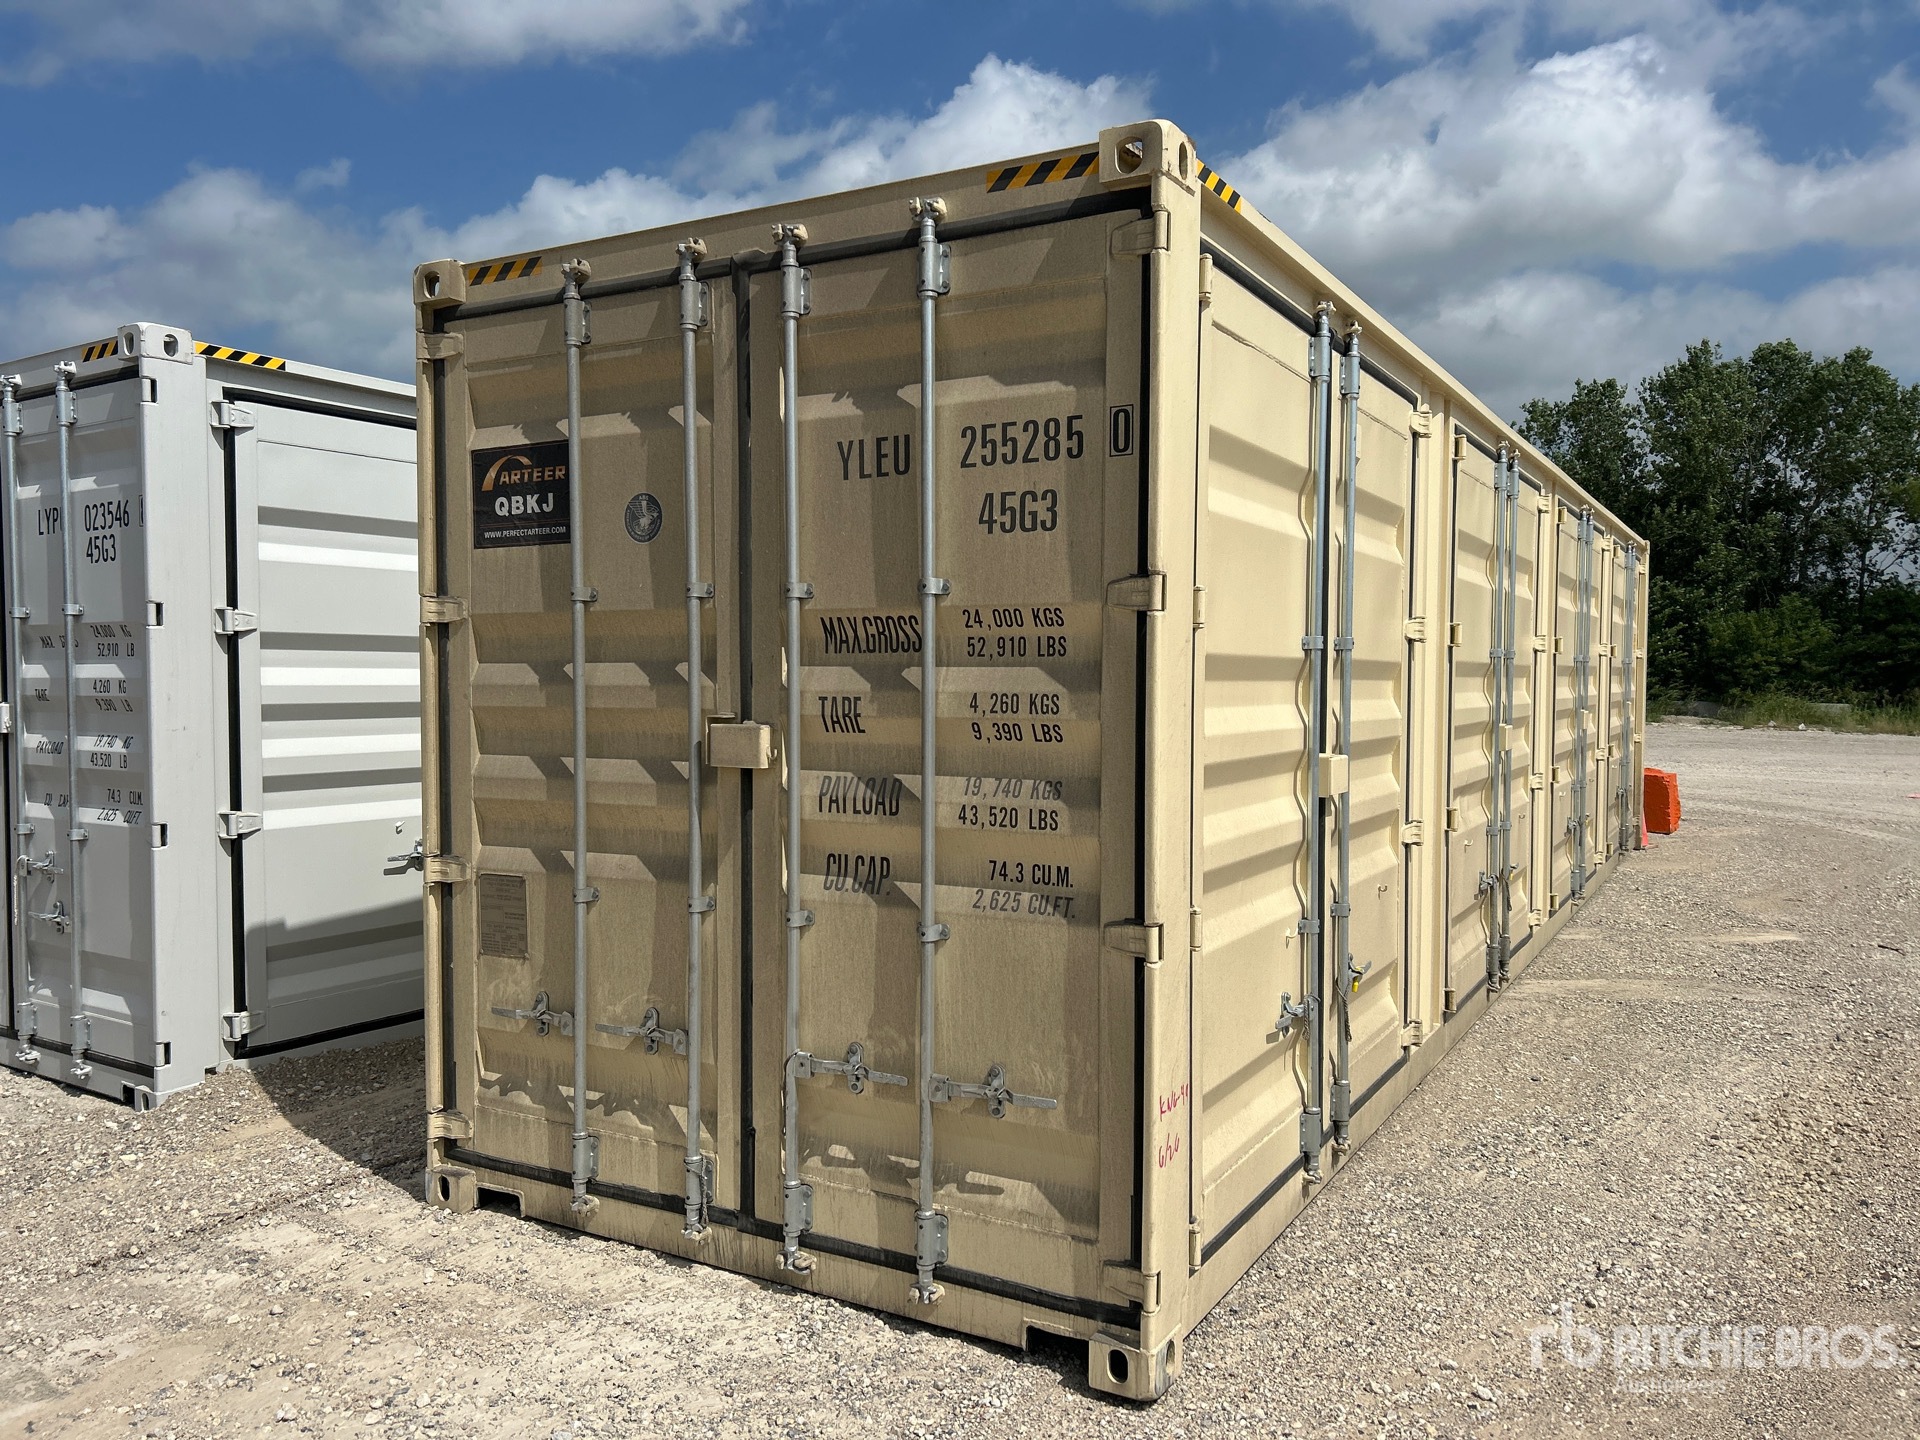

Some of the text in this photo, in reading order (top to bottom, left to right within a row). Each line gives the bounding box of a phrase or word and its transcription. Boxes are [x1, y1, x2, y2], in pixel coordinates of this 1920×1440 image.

[838, 407, 1132, 480] YLEU 255285 0
[38, 506, 64, 536] LYP
[84, 499, 130, 532] 023546
[494, 493, 554, 517] QBKJ
[978, 488, 1058, 535] 45G3
[484, 526, 566, 539] WWW.PERFECTARTEER.COM
[86, 533, 117, 564] 45G3
[962, 607, 1065, 631] 24,000 KGS
[820, 615, 923, 654] MAX.GROSS
[967, 635, 1067, 660] 52,910 LBS
[126, 643, 135, 657] LB
[118, 679, 127, 694] KG
[818, 696, 866, 734] TARE
[969, 692, 1061, 718] 4,260 KGS
[971, 721, 1064, 744] 9,390 LBS
[36, 740, 65, 755] PAYLOAD
[119, 754, 128, 769] LB
[818, 775, 902, 817] PAYLOAD
[963, 775, 1064, 802] 19,740 KGS
[958, 804, 1060, 832] 43,520 LBS
[823, 852, 892, 896] CU.CAP.
[988, 859, 1075, 889] 74.3 CU.M.
[972, 887, 1077, 919] 2,625 CU.FT.
